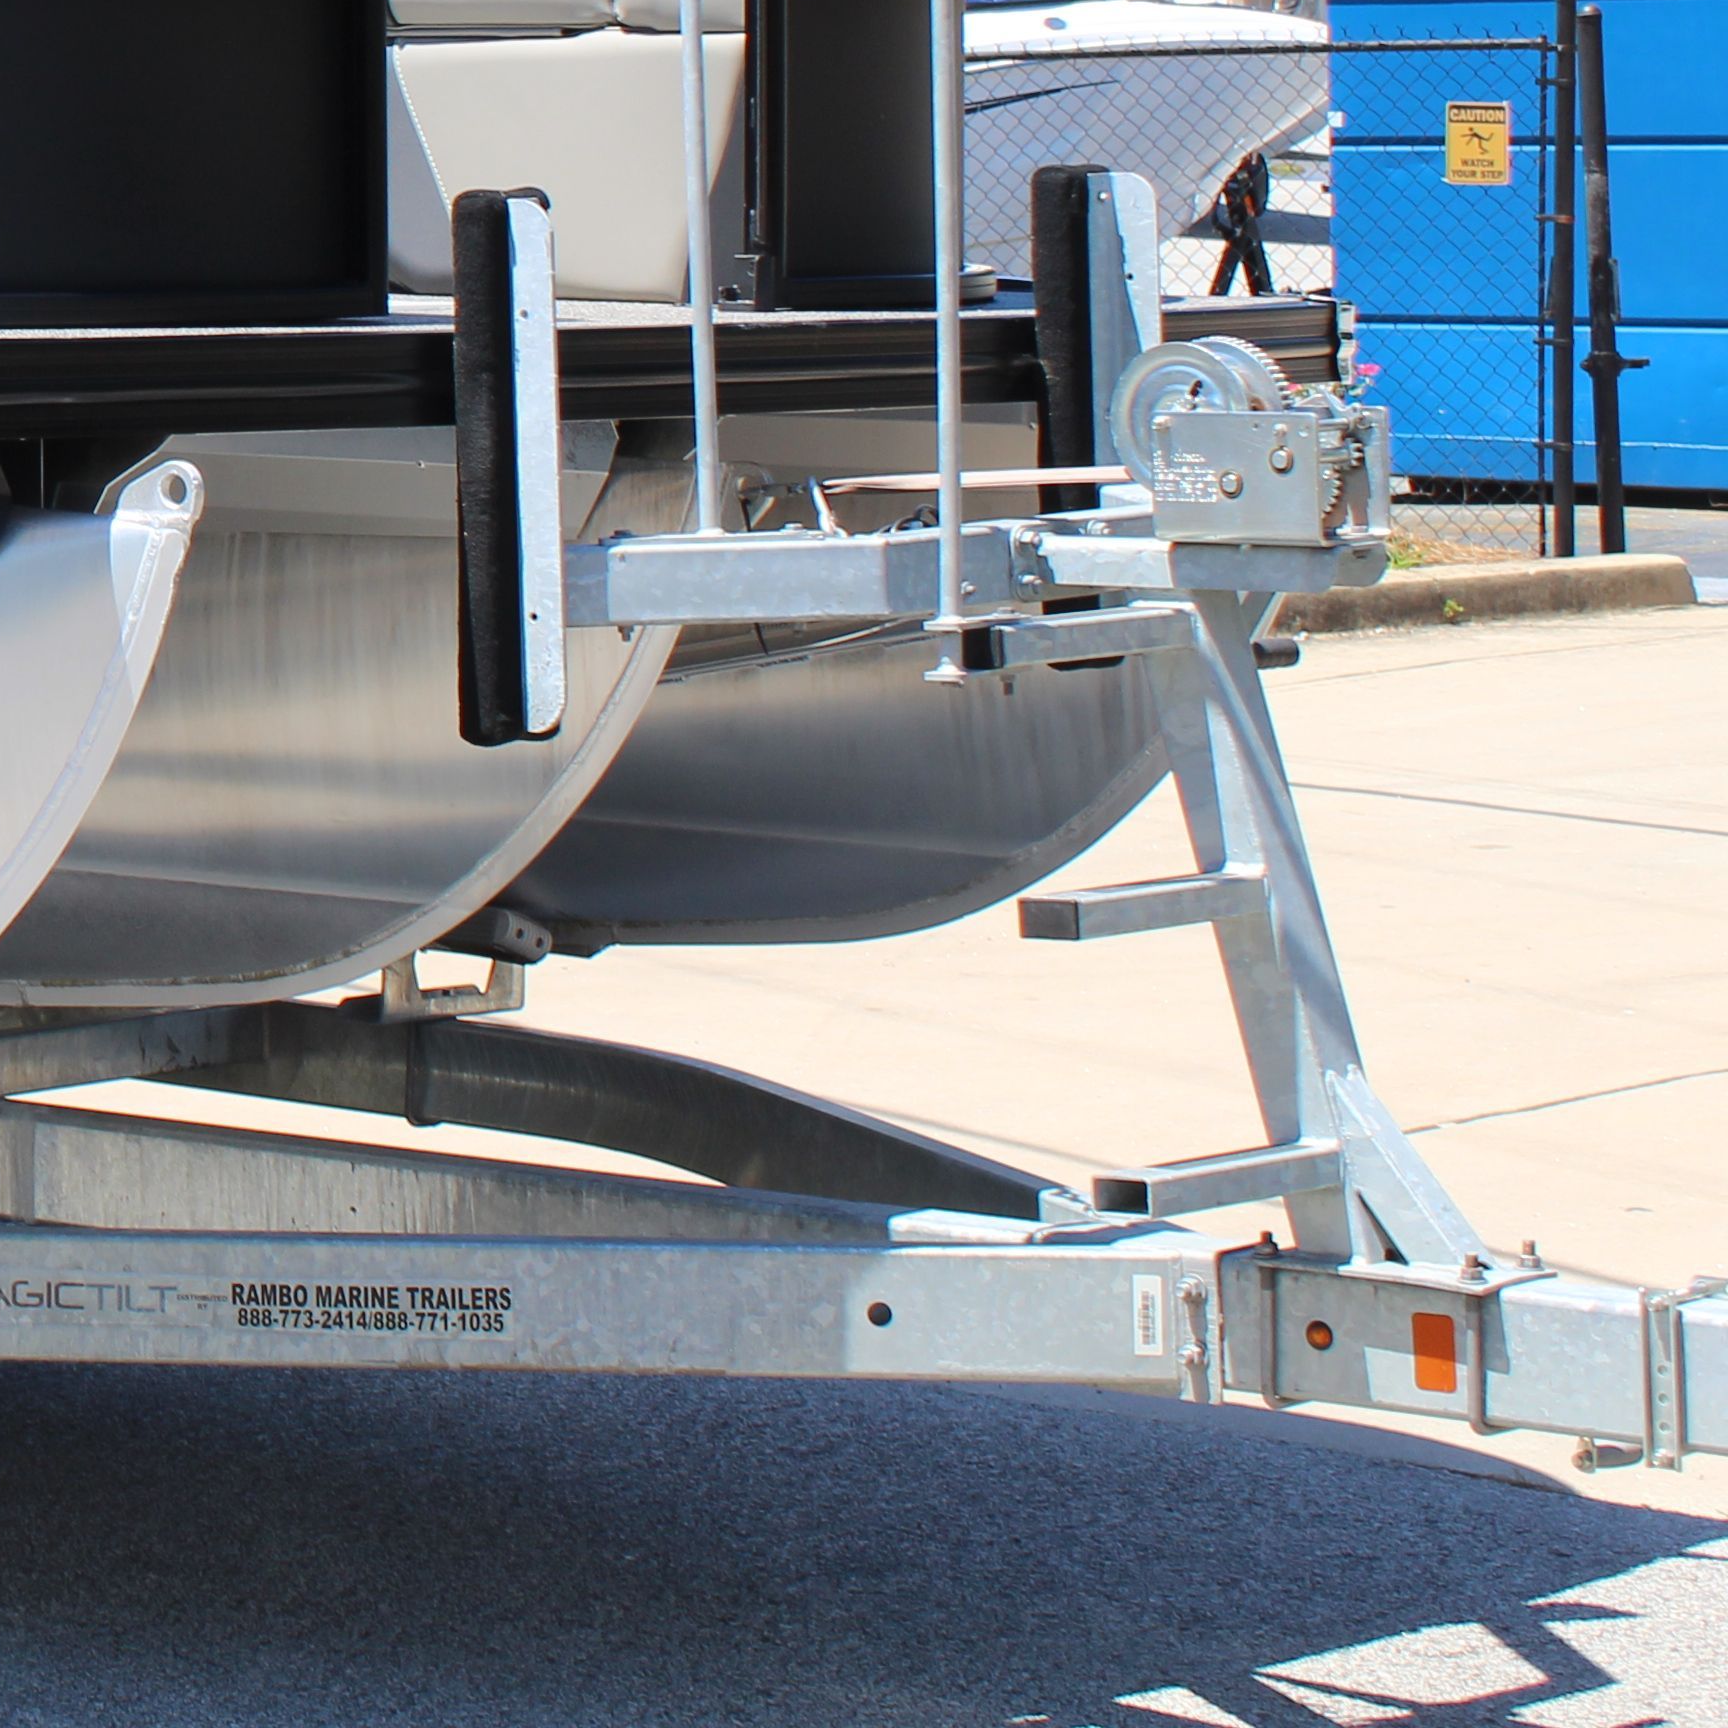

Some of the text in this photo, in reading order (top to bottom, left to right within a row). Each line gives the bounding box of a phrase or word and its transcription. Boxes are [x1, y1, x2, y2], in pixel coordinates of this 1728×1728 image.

[1450, 108, 1504, 123] CAUTION
[1460, 158, 1495, 168] WATCH
[1451, 169, 1504, 180] YOUR STEP
[231, 1282, 513, 1311] RAMBO MARINE TRAILERS
[237, 1307, 505, 1333] 888-773-2414/888-771-1035
